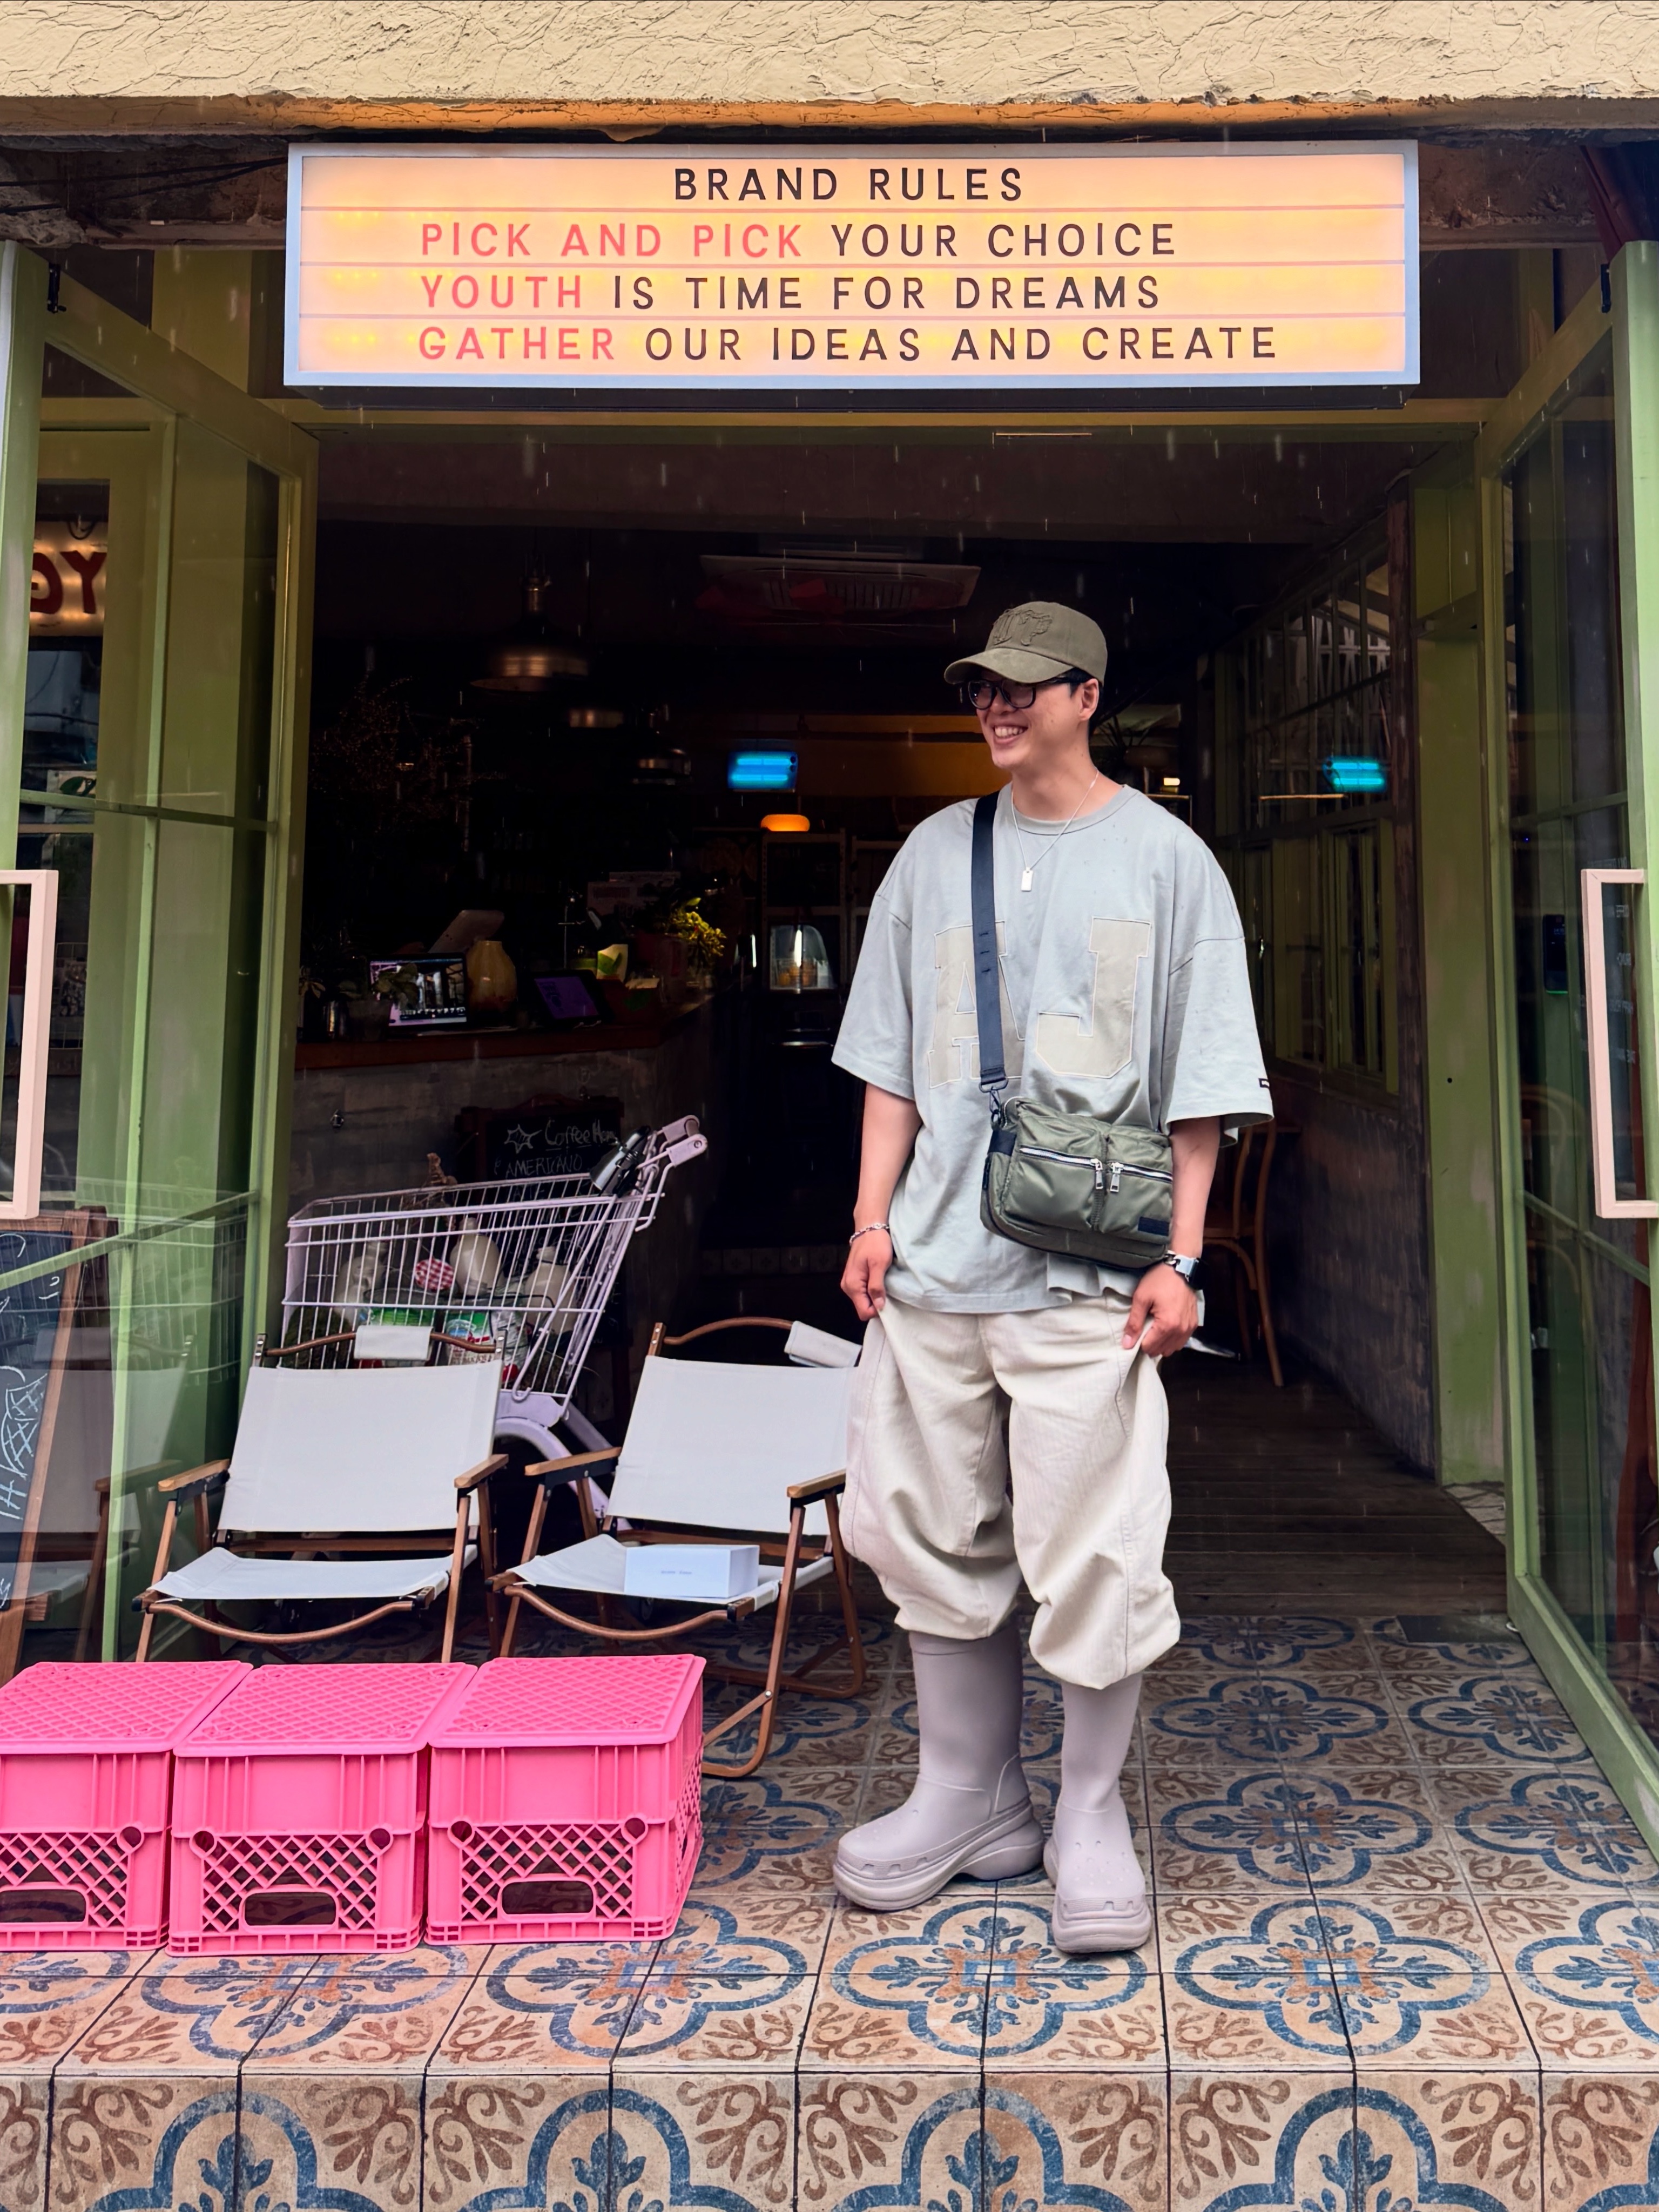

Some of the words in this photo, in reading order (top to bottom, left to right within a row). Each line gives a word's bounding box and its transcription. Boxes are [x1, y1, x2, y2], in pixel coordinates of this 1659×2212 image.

[674, 166, 838, 201] BRAND
[869, 166, 1022, 202] RULES
[422, 222, 530, 257] PICK
[561, 223, 661, 257] AND
[694, 223, 801, 258] PICK
[830, 223, 958, 258] YOUR
[987, 222, 1175, 258] CHOICE
[421, 275, 581, 309] YOUTH
[614, 275, 654, 311] IS
[685, 275, 802, 311] TIME
[833, 275, 925, 311] FOR
[955, 275, 1159, 310] DREAMS
[419, 326, 614, 360] GATHER
[645, 327, 741, 361] OUR
[772, 327, 920, 362] IDEAS
[950, 327, 1051, 361] AND
[1082, 326, 1276, 361] CREATE
[544, 1118, 591, 1147] Coffee
[505, 1153, 583, 1179] AMERICANO
